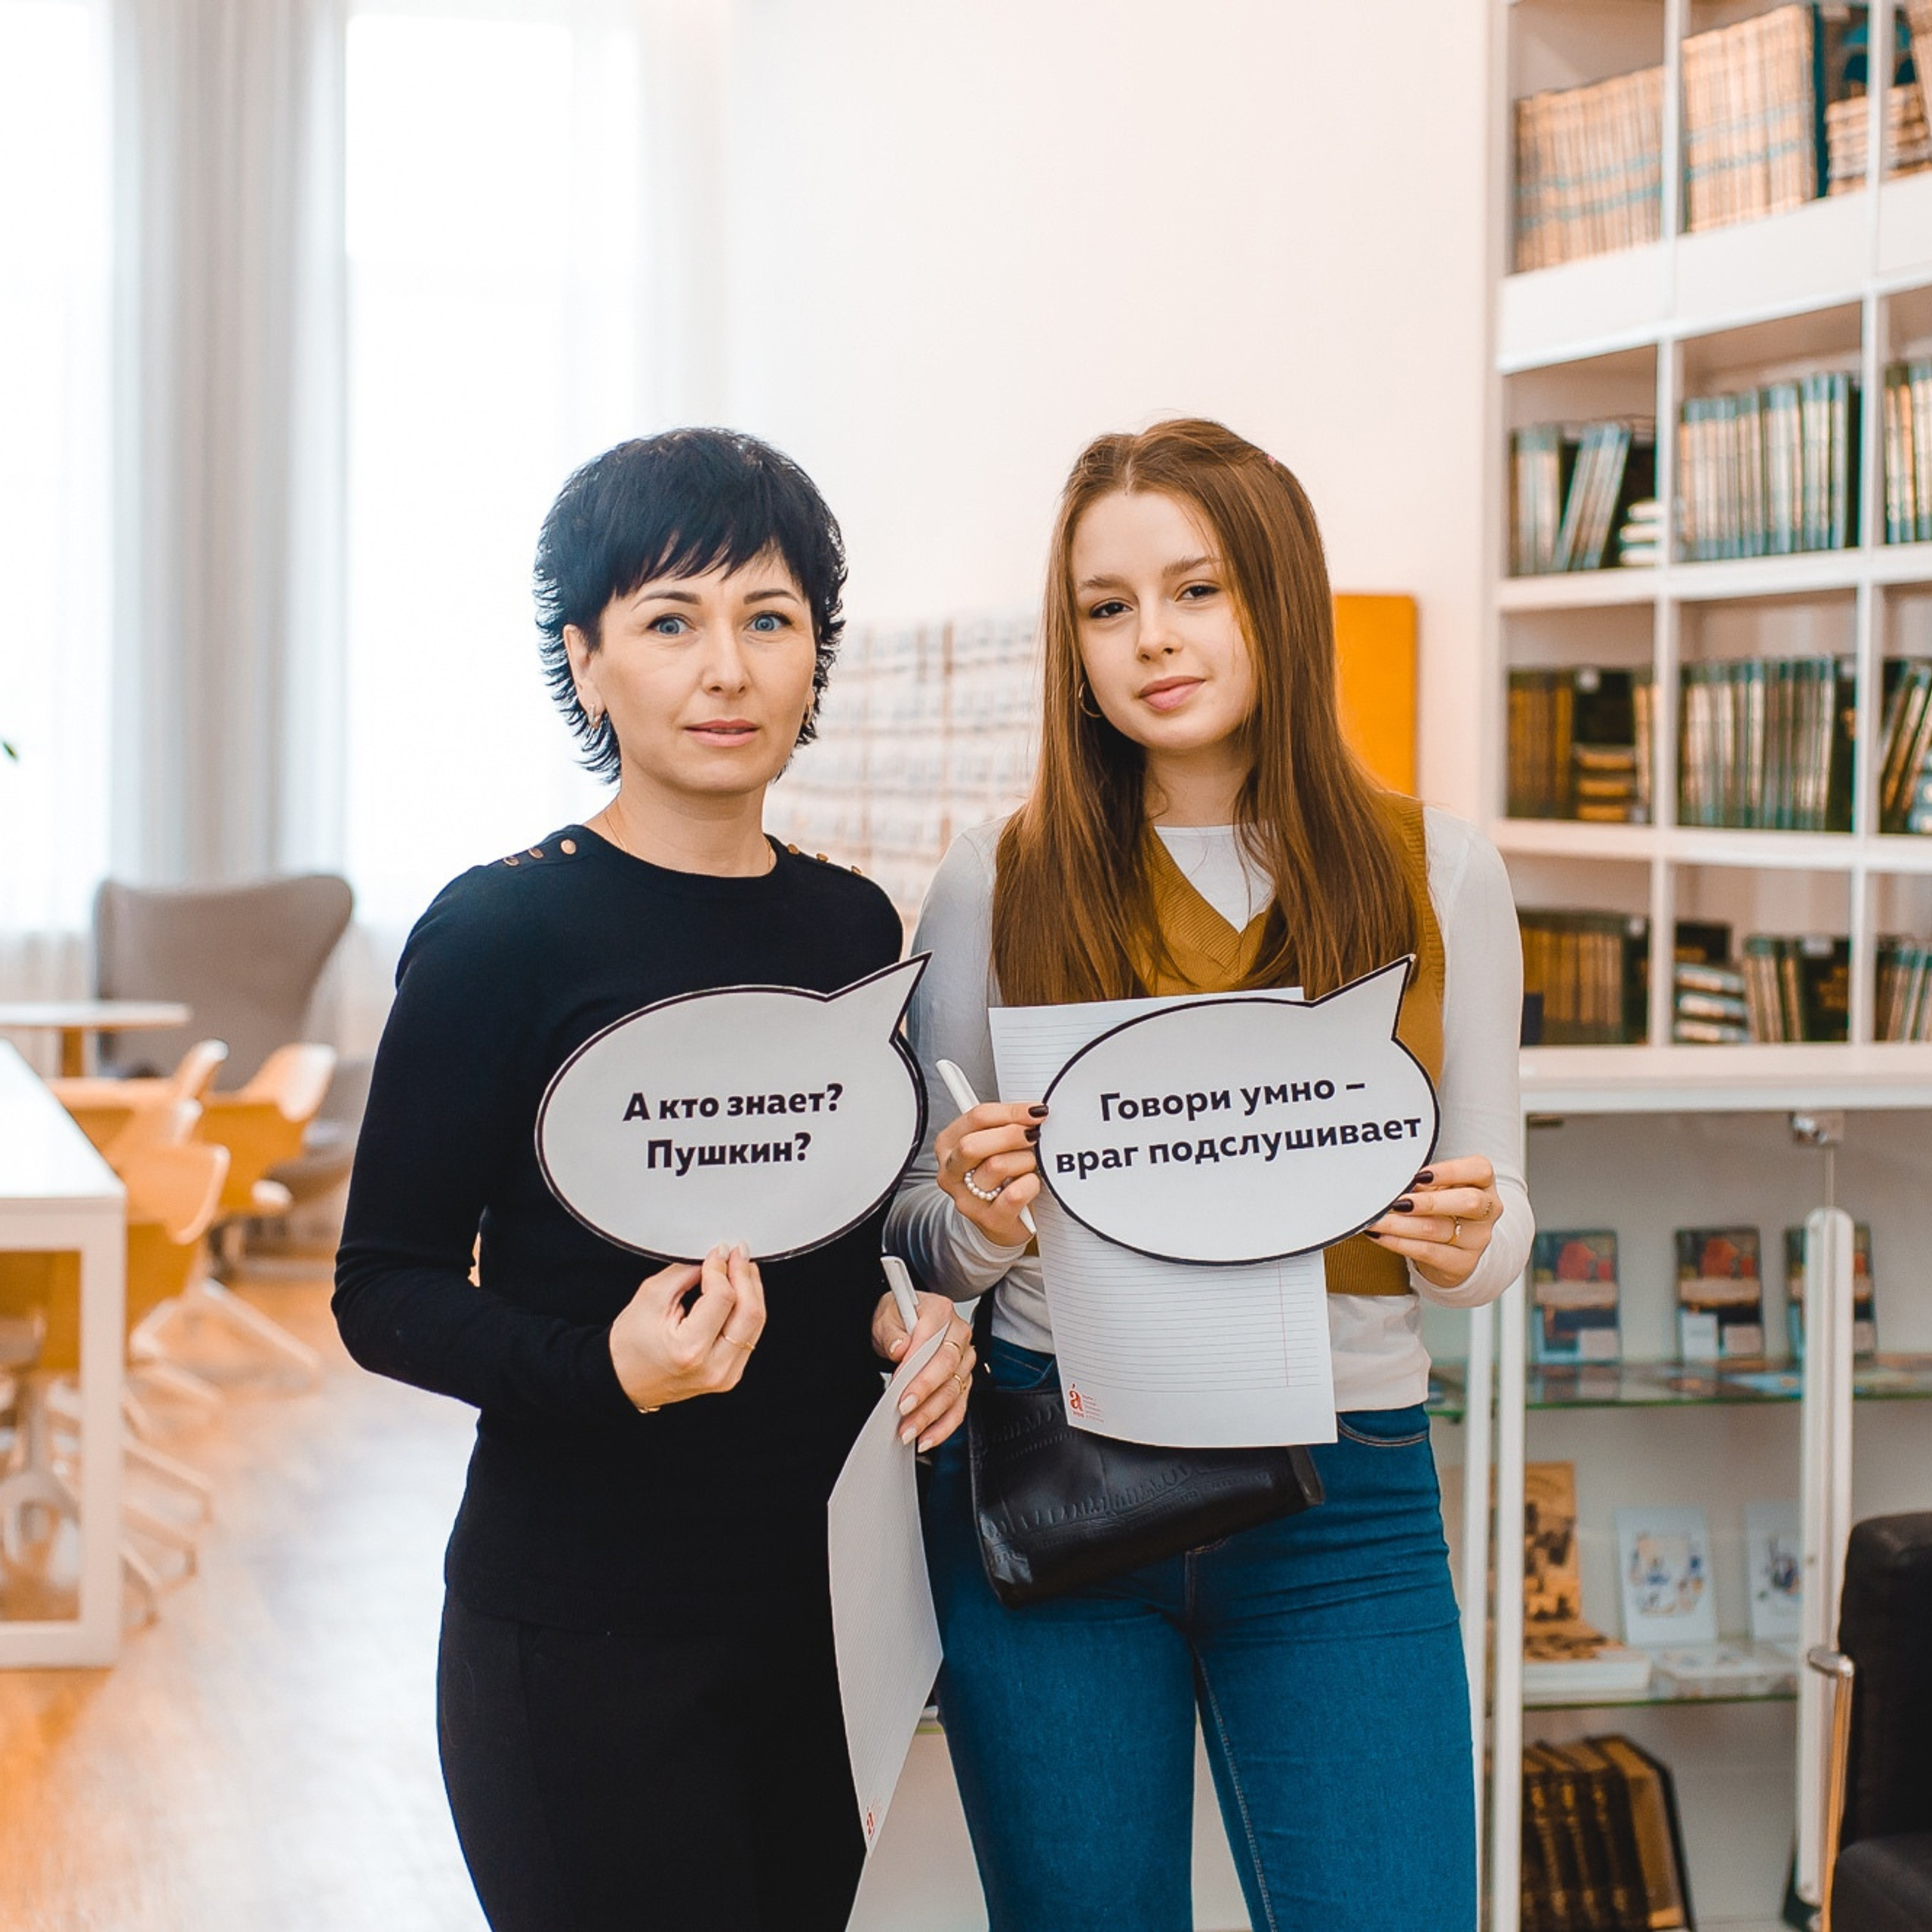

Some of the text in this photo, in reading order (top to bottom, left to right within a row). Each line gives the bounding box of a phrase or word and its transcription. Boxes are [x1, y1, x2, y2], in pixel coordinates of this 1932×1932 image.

[623, 1083, 844, 1121] А кто знает?
[1100, 1085, 1231, 1121] Говори
[1239, 1078, 1335, 1115] умно
[647, 1132, 812, 1177] Пушкин?
[1056, 1116, 1422, 1180] враг подслушивает
